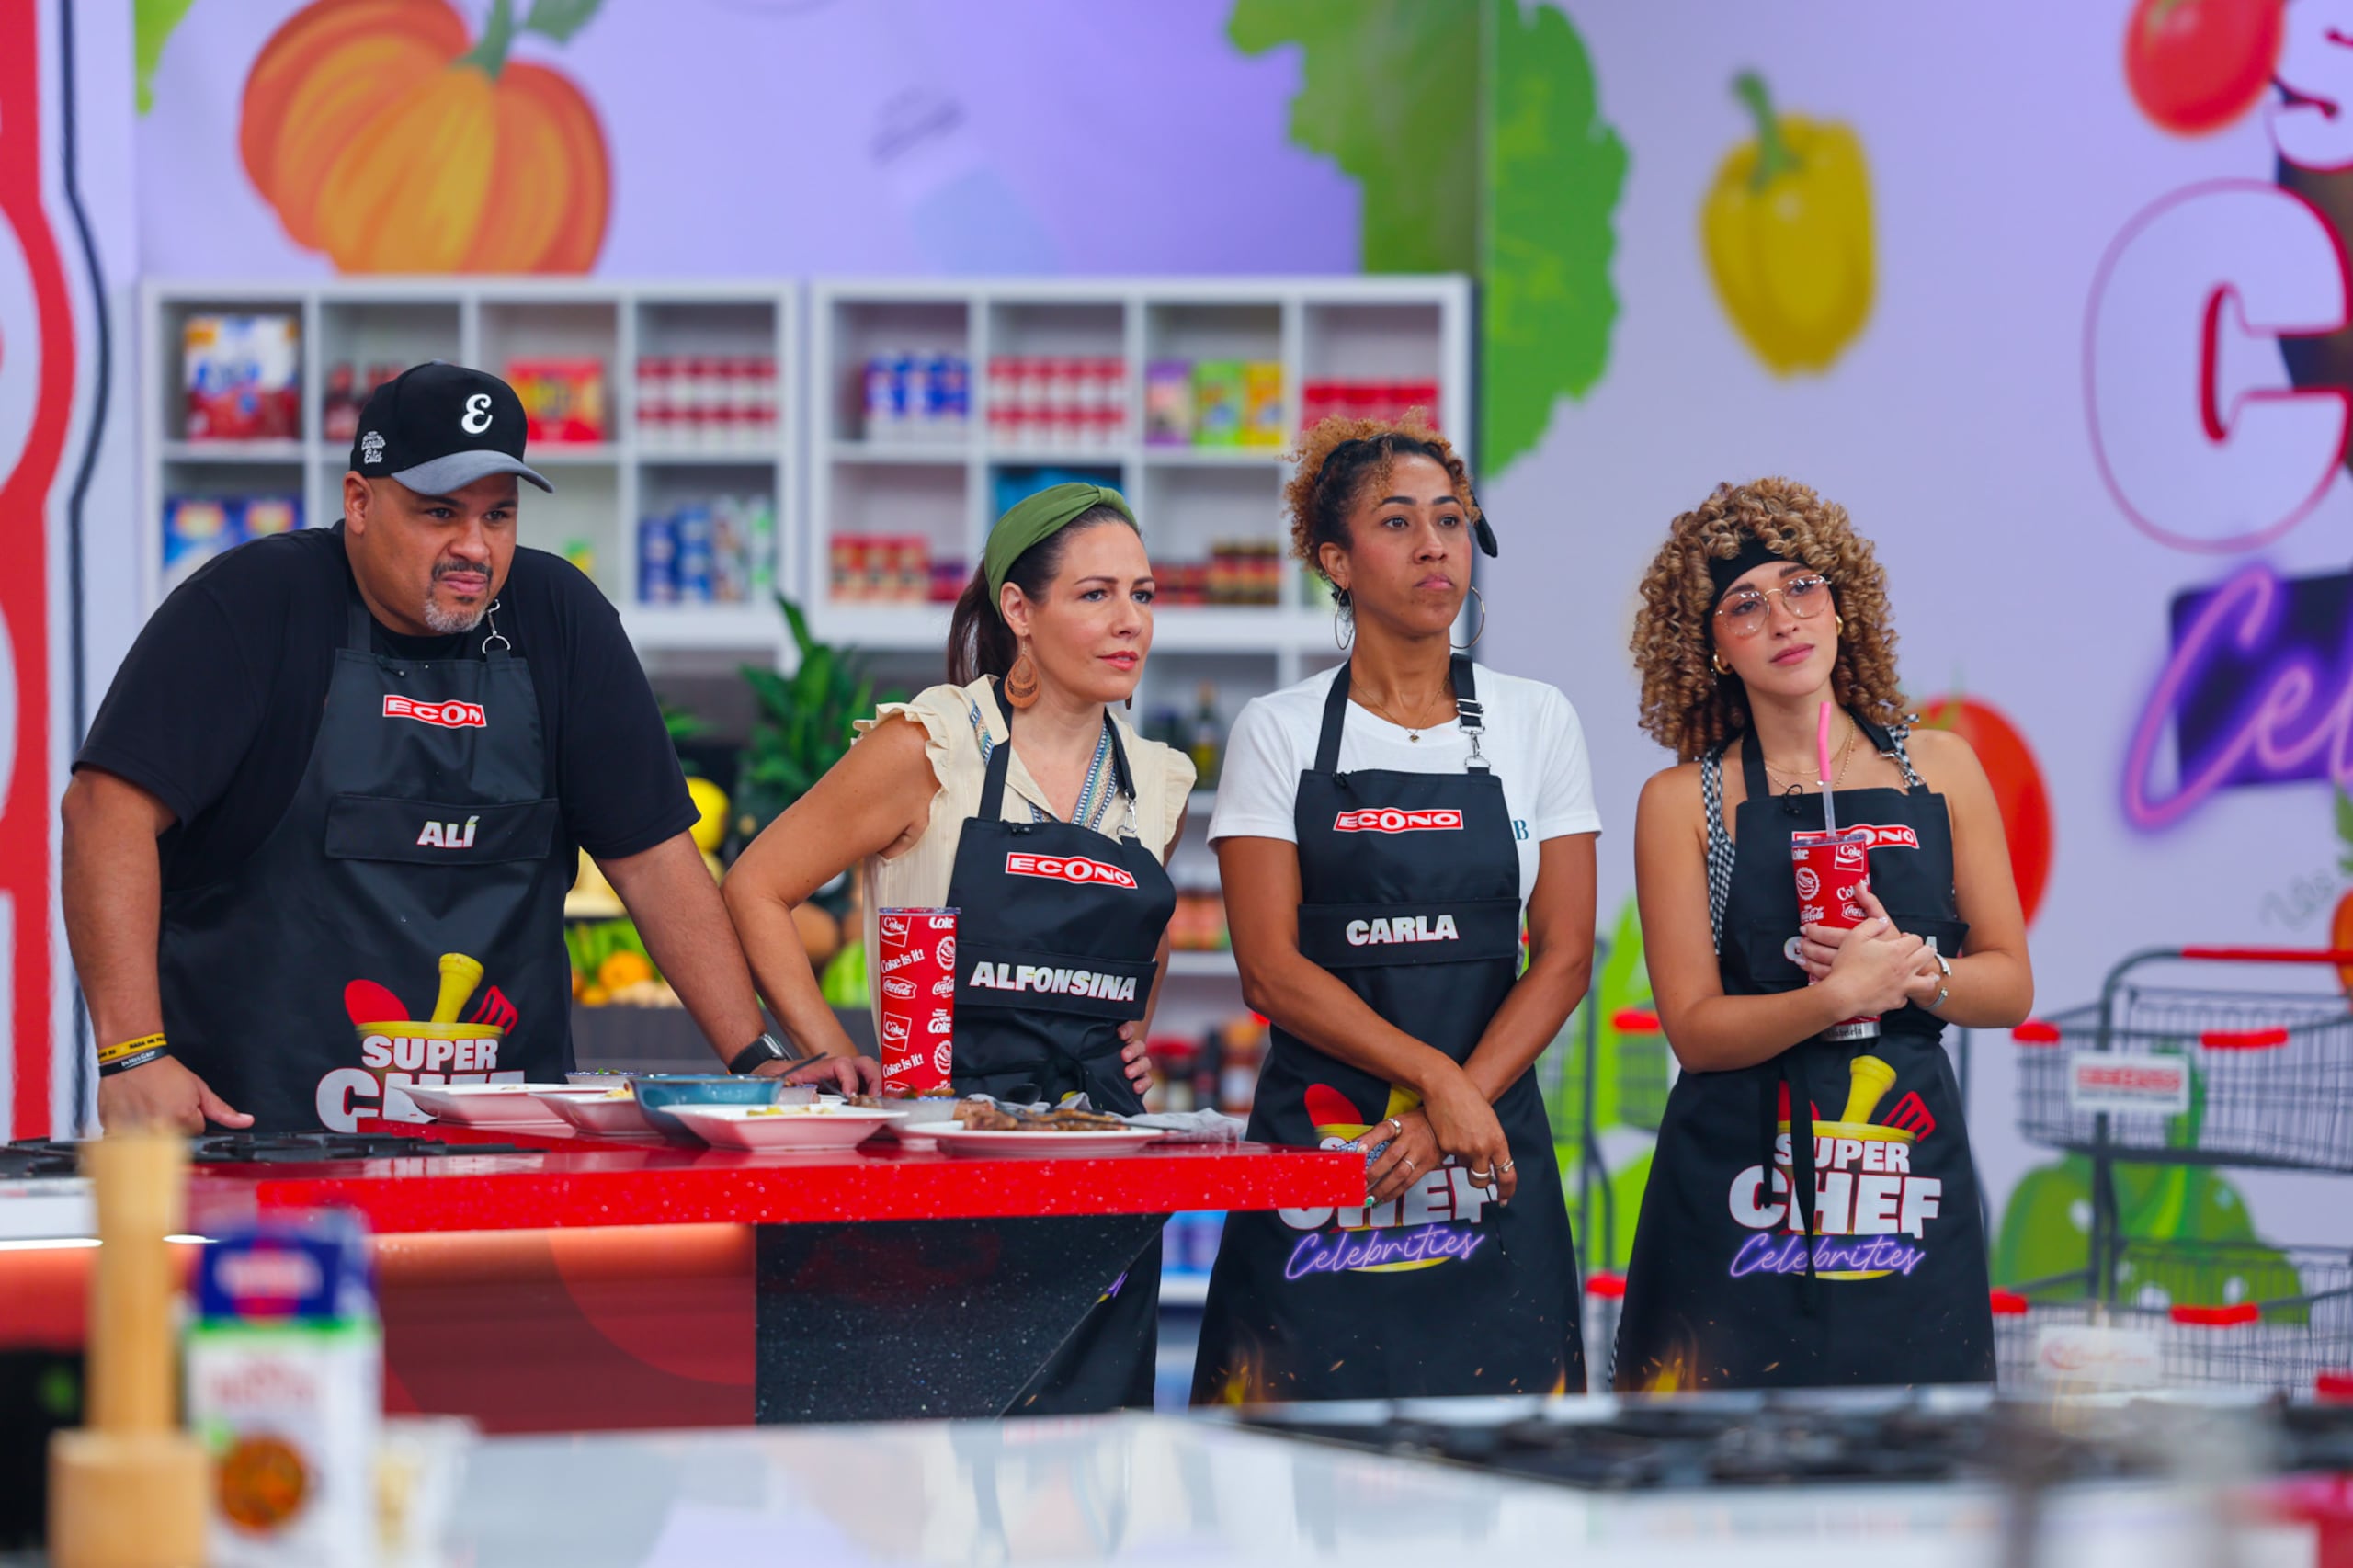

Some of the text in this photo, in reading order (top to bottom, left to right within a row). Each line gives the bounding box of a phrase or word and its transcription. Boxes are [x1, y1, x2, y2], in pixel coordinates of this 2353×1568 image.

[461, 393, 493, 434] E
[416, 815, 480, 848] ALÍ
[1338, 812, 1460, 830] ECONO
[1840, 845, 1862, 858] Coke
[1010, 857, 1131, 885] ECONO
[883, 916, 905, 931] Coke
[1346, 915, 1459, 946] CARLA
[881, 959, 902, 973] Coke
[900, 953, 912, 966] is
[970, 961, 1138, 1002] ALFONSINA
[885, 1020, 905, 1036] Coke
[361, 1035, 499, 1071] SUPER
[882, 1064, 903, 1078] Coke
[900, 1059, 913, 1071] is
[910, 1053, 924, 1067] it!
[1774, 1133, 1910, 1174] SUPER
[1729, 1165, 1942, 1240] CHEF
[1284, 1224, 1486, 1279] Celebrities
[1729, 1232, 1926, 1278] Celebrities
